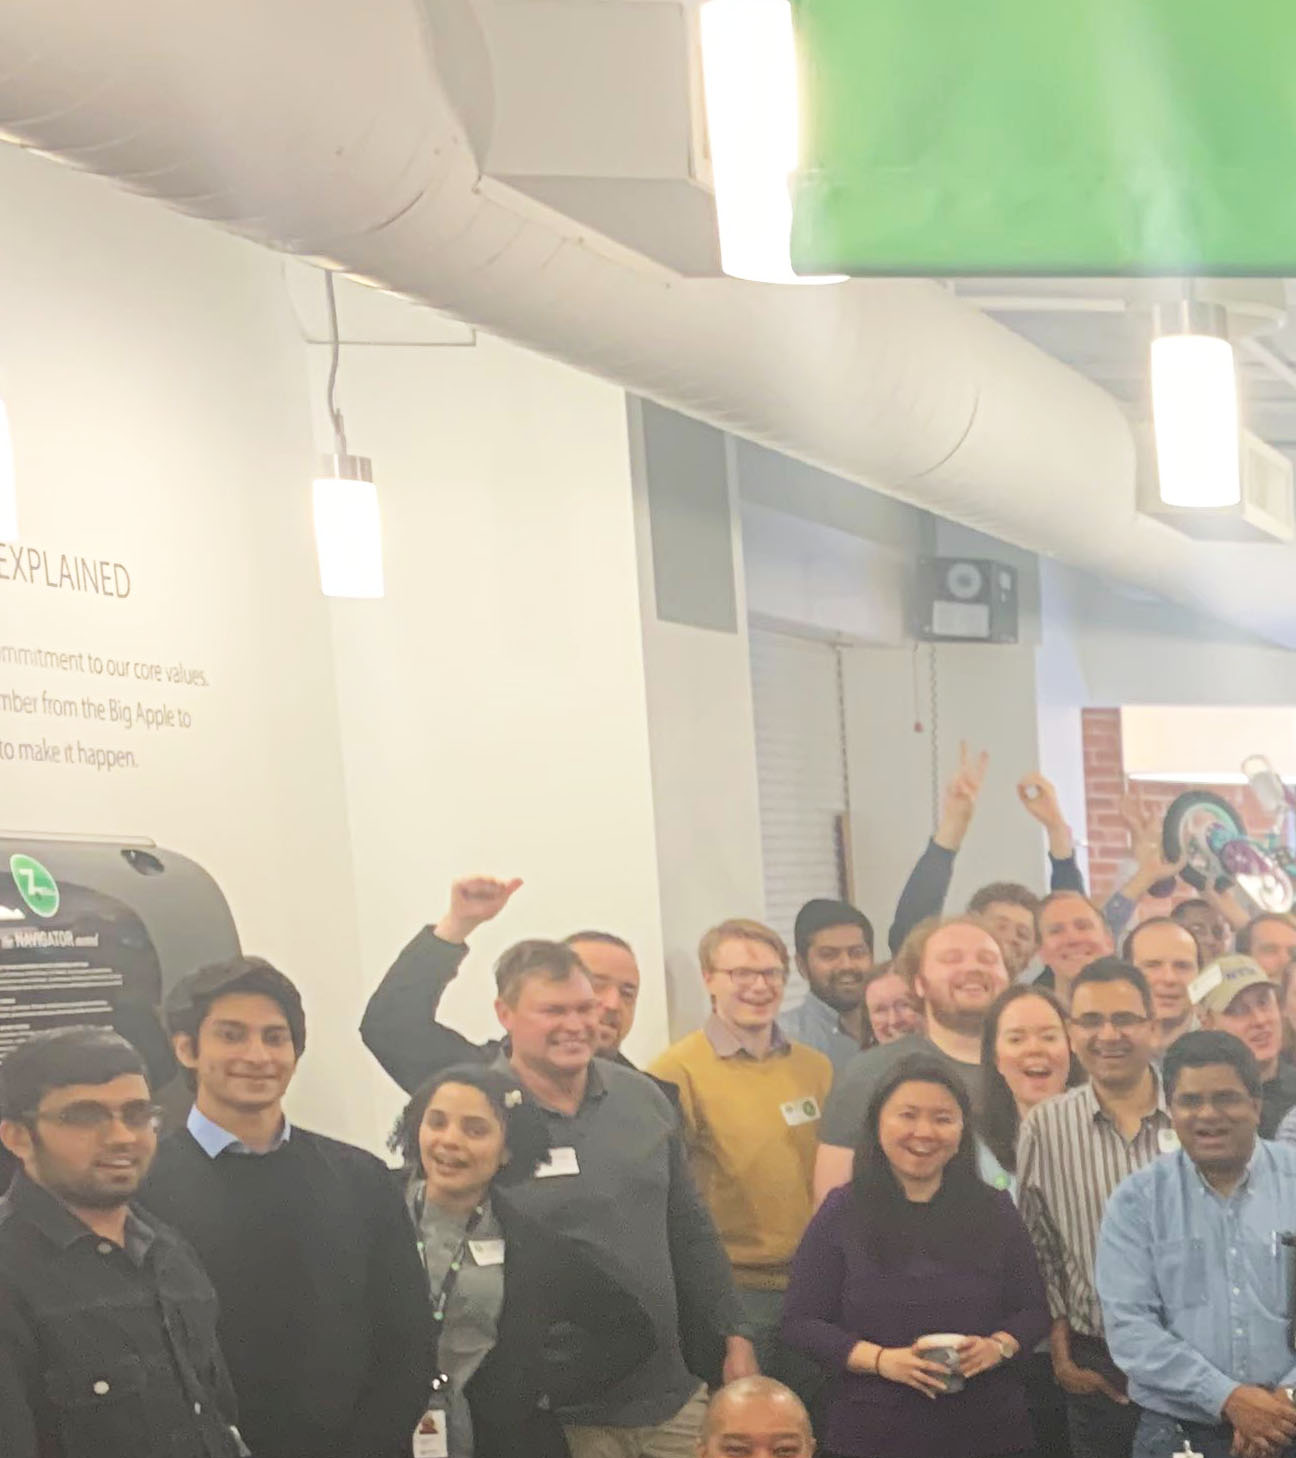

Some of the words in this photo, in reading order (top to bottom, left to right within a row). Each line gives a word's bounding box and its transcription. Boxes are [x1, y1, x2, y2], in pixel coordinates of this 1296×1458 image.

[0, 543, 130, 598] EXPLAINED
[88, 653, 103, 674] to
[106, 659, 130, 677] our
[134, 661, 162, 682] core
[42, 690, 77, 717] from
[81, 697, 106, 721] the
[109, 698, 132, 729] Big
[136, 702, 175, 731] Apple
[178, 708, 192, 728] to
[18, 738, 61, 764] make
[65, 745, 75, 764] it
[77, 741, 138, 772] happen.
